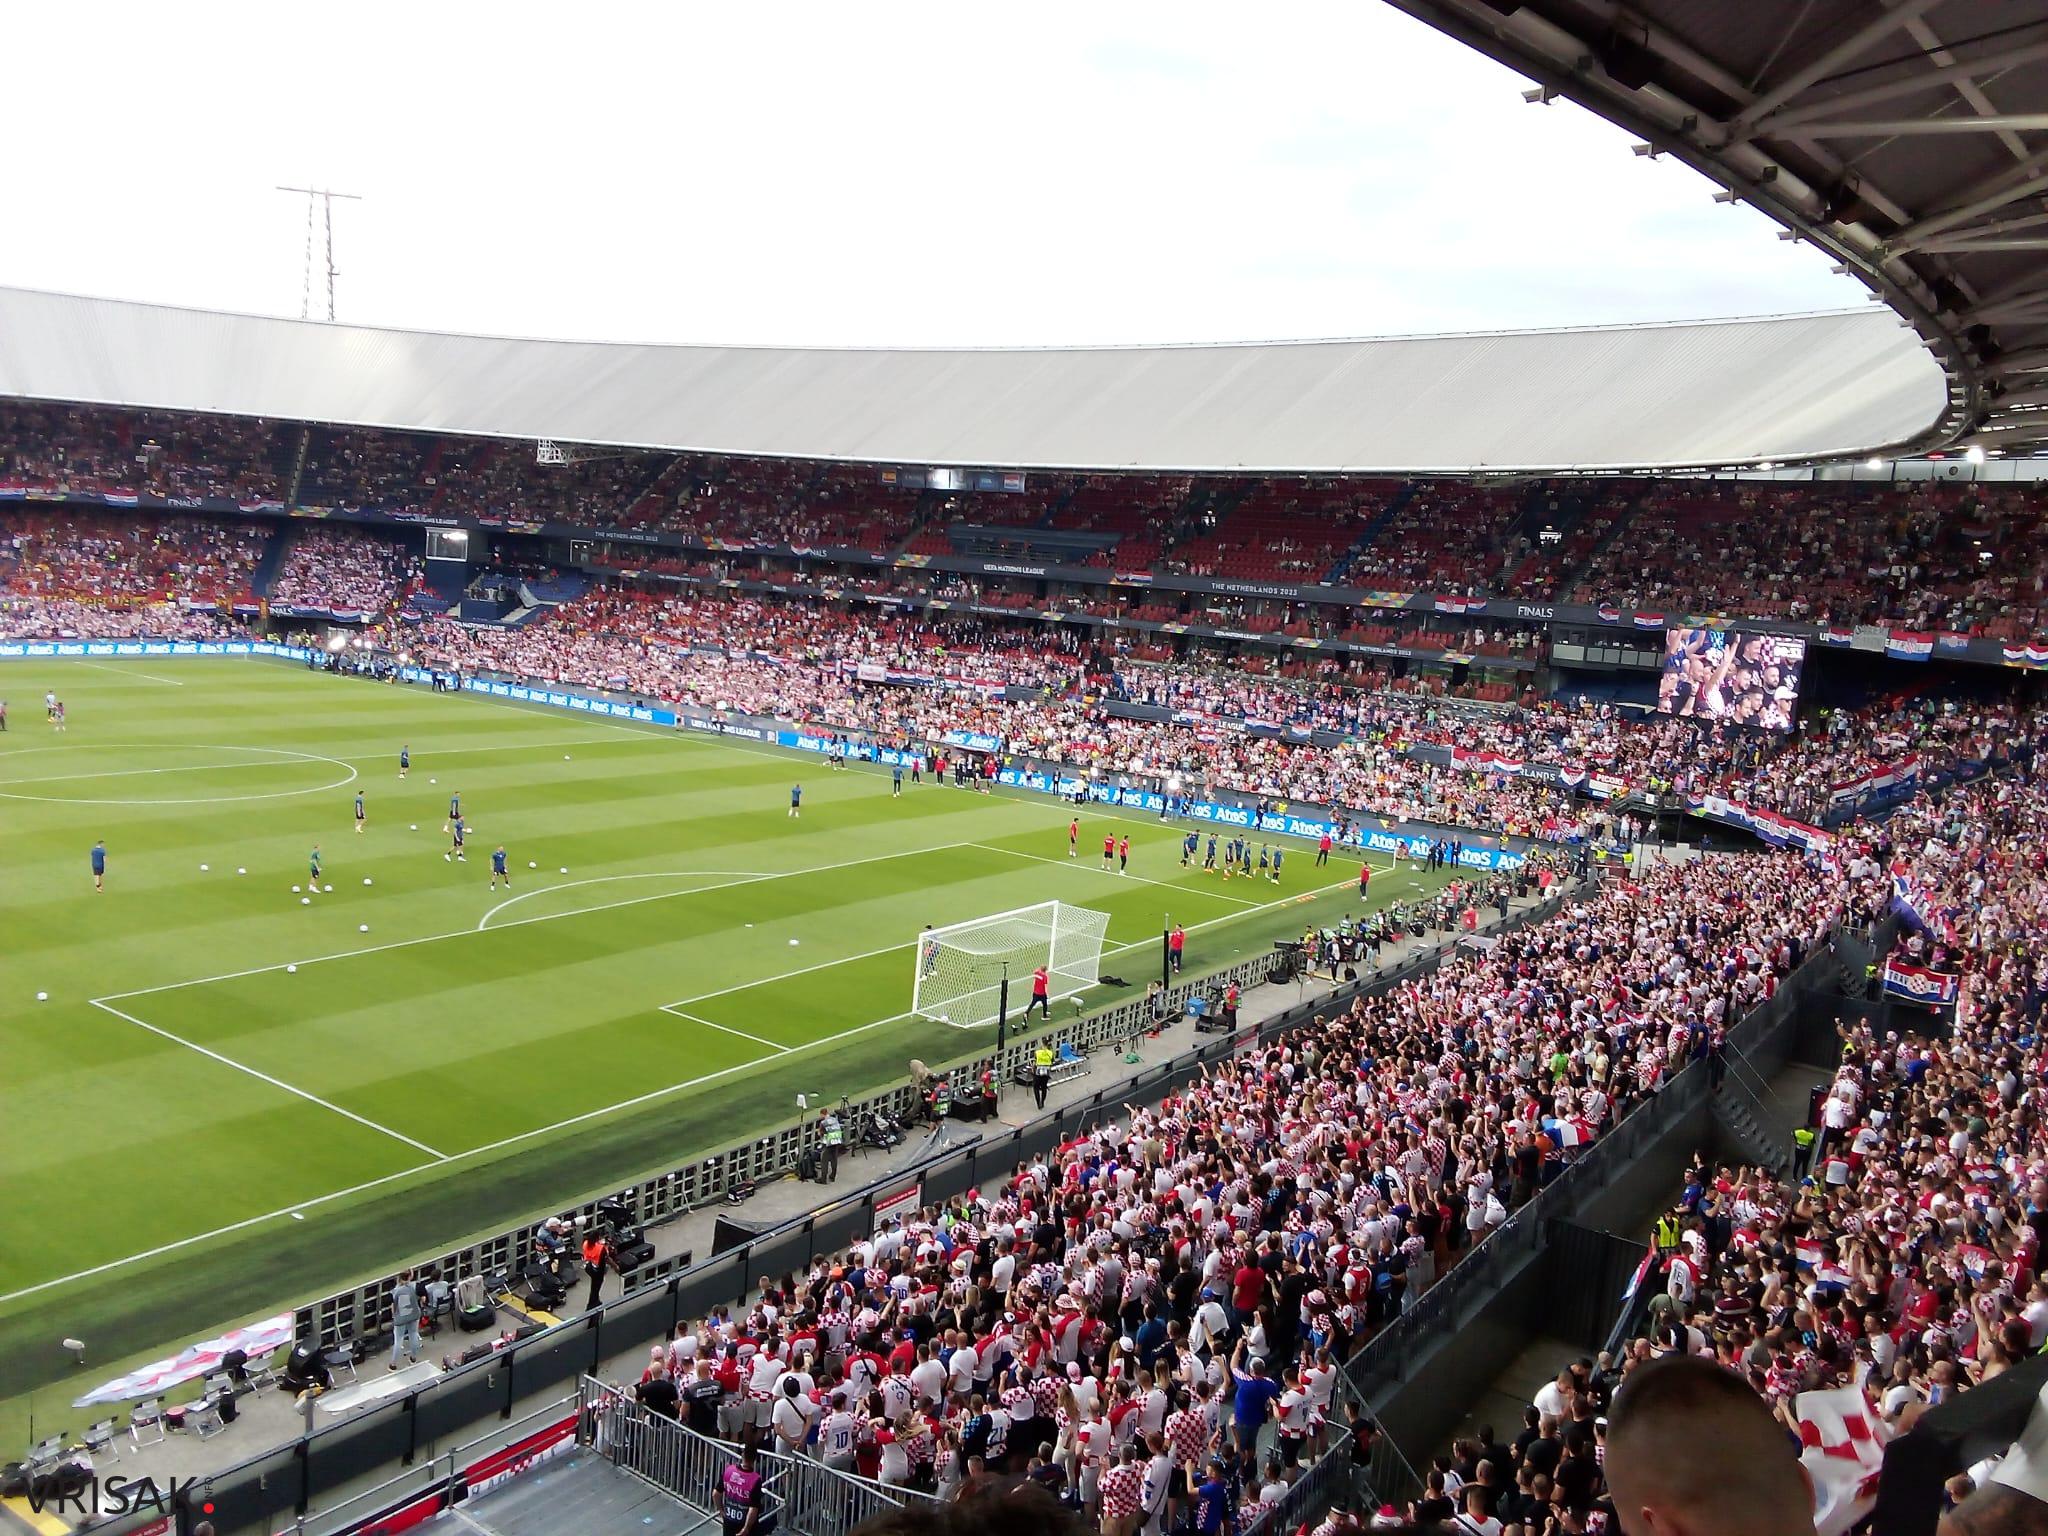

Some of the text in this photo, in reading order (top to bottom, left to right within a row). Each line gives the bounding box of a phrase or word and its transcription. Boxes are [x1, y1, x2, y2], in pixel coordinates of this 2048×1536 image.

[1022, 566, 1046, 576] LEAGUE
[1211, 582, 1298, 597] THE NETHERLANDS 2023
[1517, 605, 1554, 618] FINALS
[1519, 768, 1556, 782] RLANDS
[836, 1430, 849, 1450] 10
